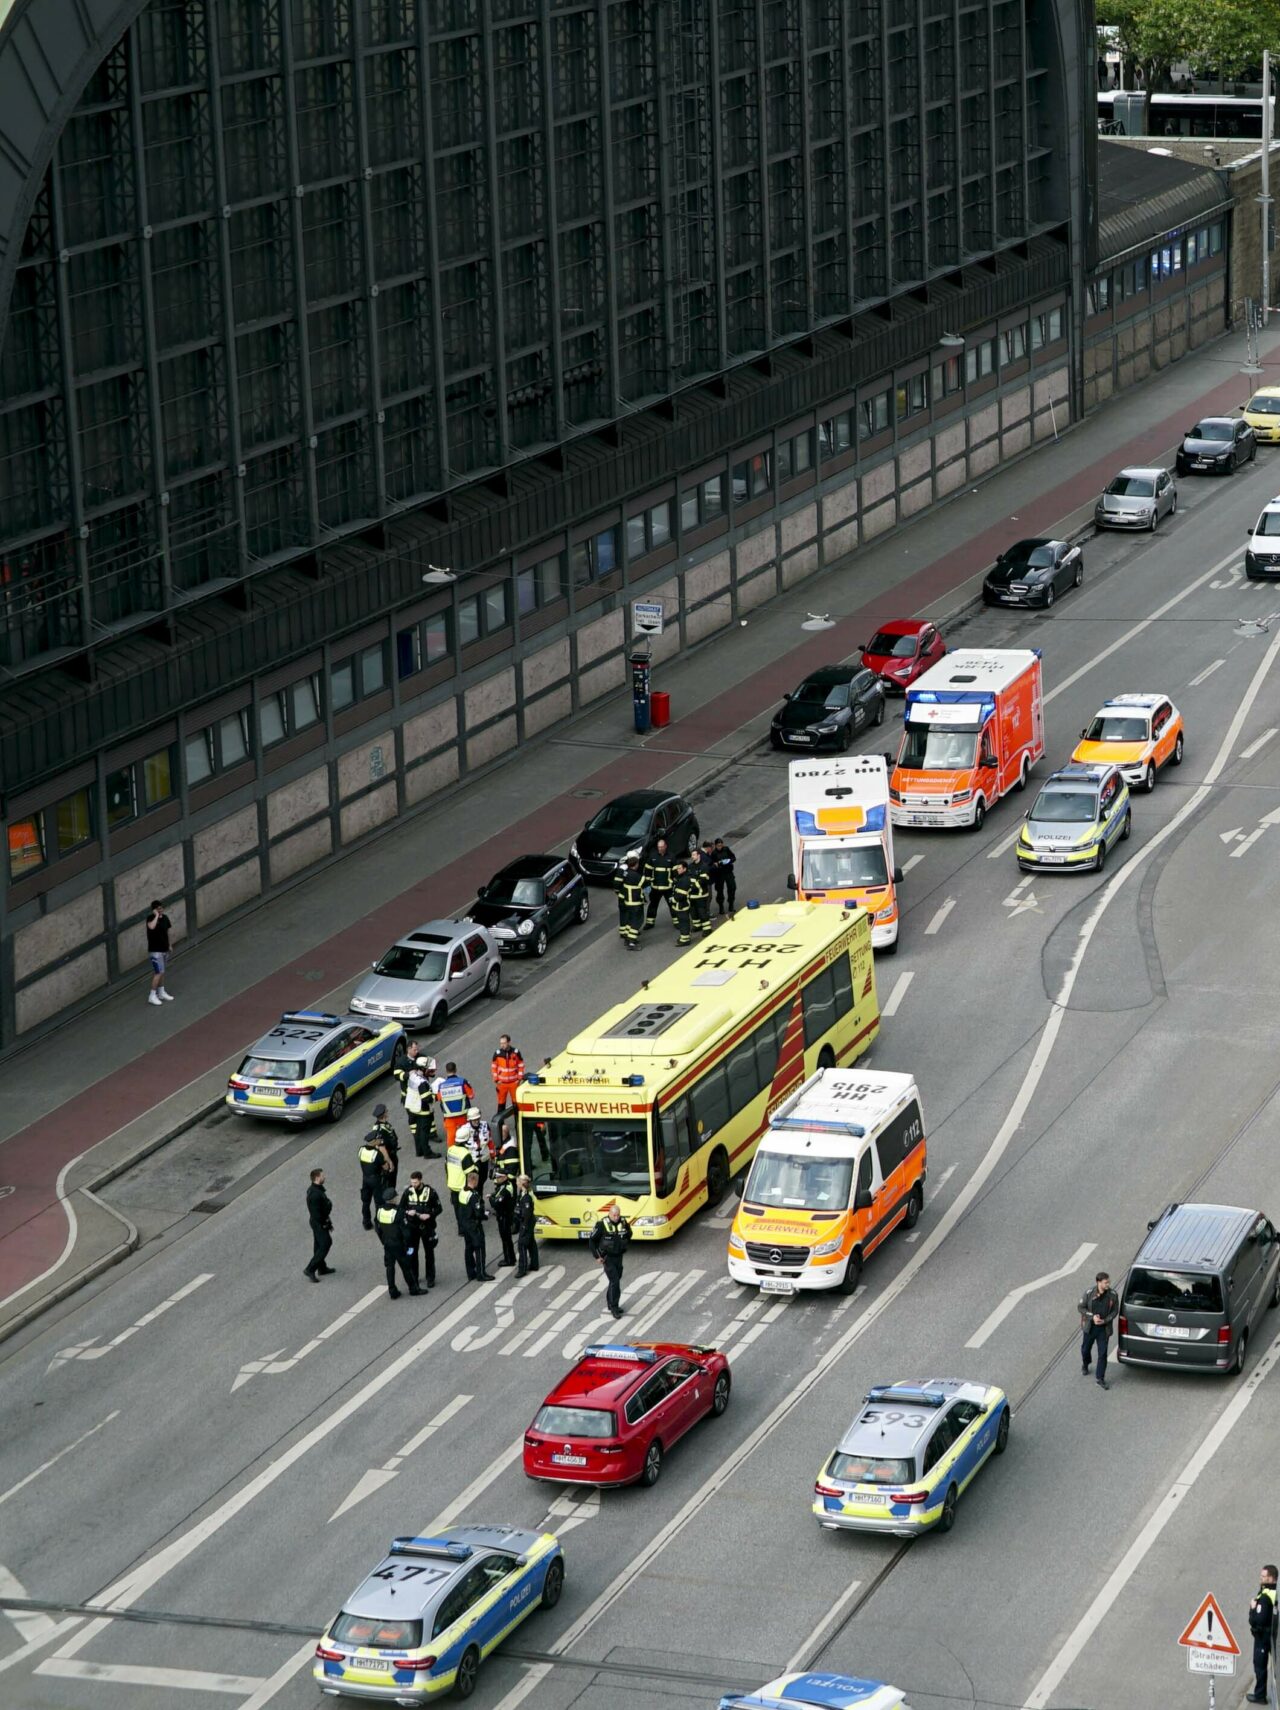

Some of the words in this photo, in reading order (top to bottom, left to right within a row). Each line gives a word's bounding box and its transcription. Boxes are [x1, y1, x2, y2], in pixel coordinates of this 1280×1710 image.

[794, 769, 847, 778] 2780
[854, 766, 881, 774] HH
[703, 943, 804, 955] 2894
[825, 927, 858, 963] FEUERWEHR
[850, 940, 872, 966] RETTUNG
[268, 1027, 324, 1041] 522
[367, 1049, 384, 1067] POLIZEI
[830, 1082, 888, 1094] 2915
[831, 1091, 867, 1101] HH
[535, 1101, 630, 1114] FEUERWEHR
[909, 1118, 921, 1141] 112
[745, 1223, 818, 1236] FEUERWEHR
[860, 1411, 927, 1428] 593
[372, 1564, 451, 1585] 477
[509, 1583, 531, 1612] POLIZEI
[1195, 1660, 1228, 1671] schäden
[805, 1678, 864, 1693] POLIZEI
